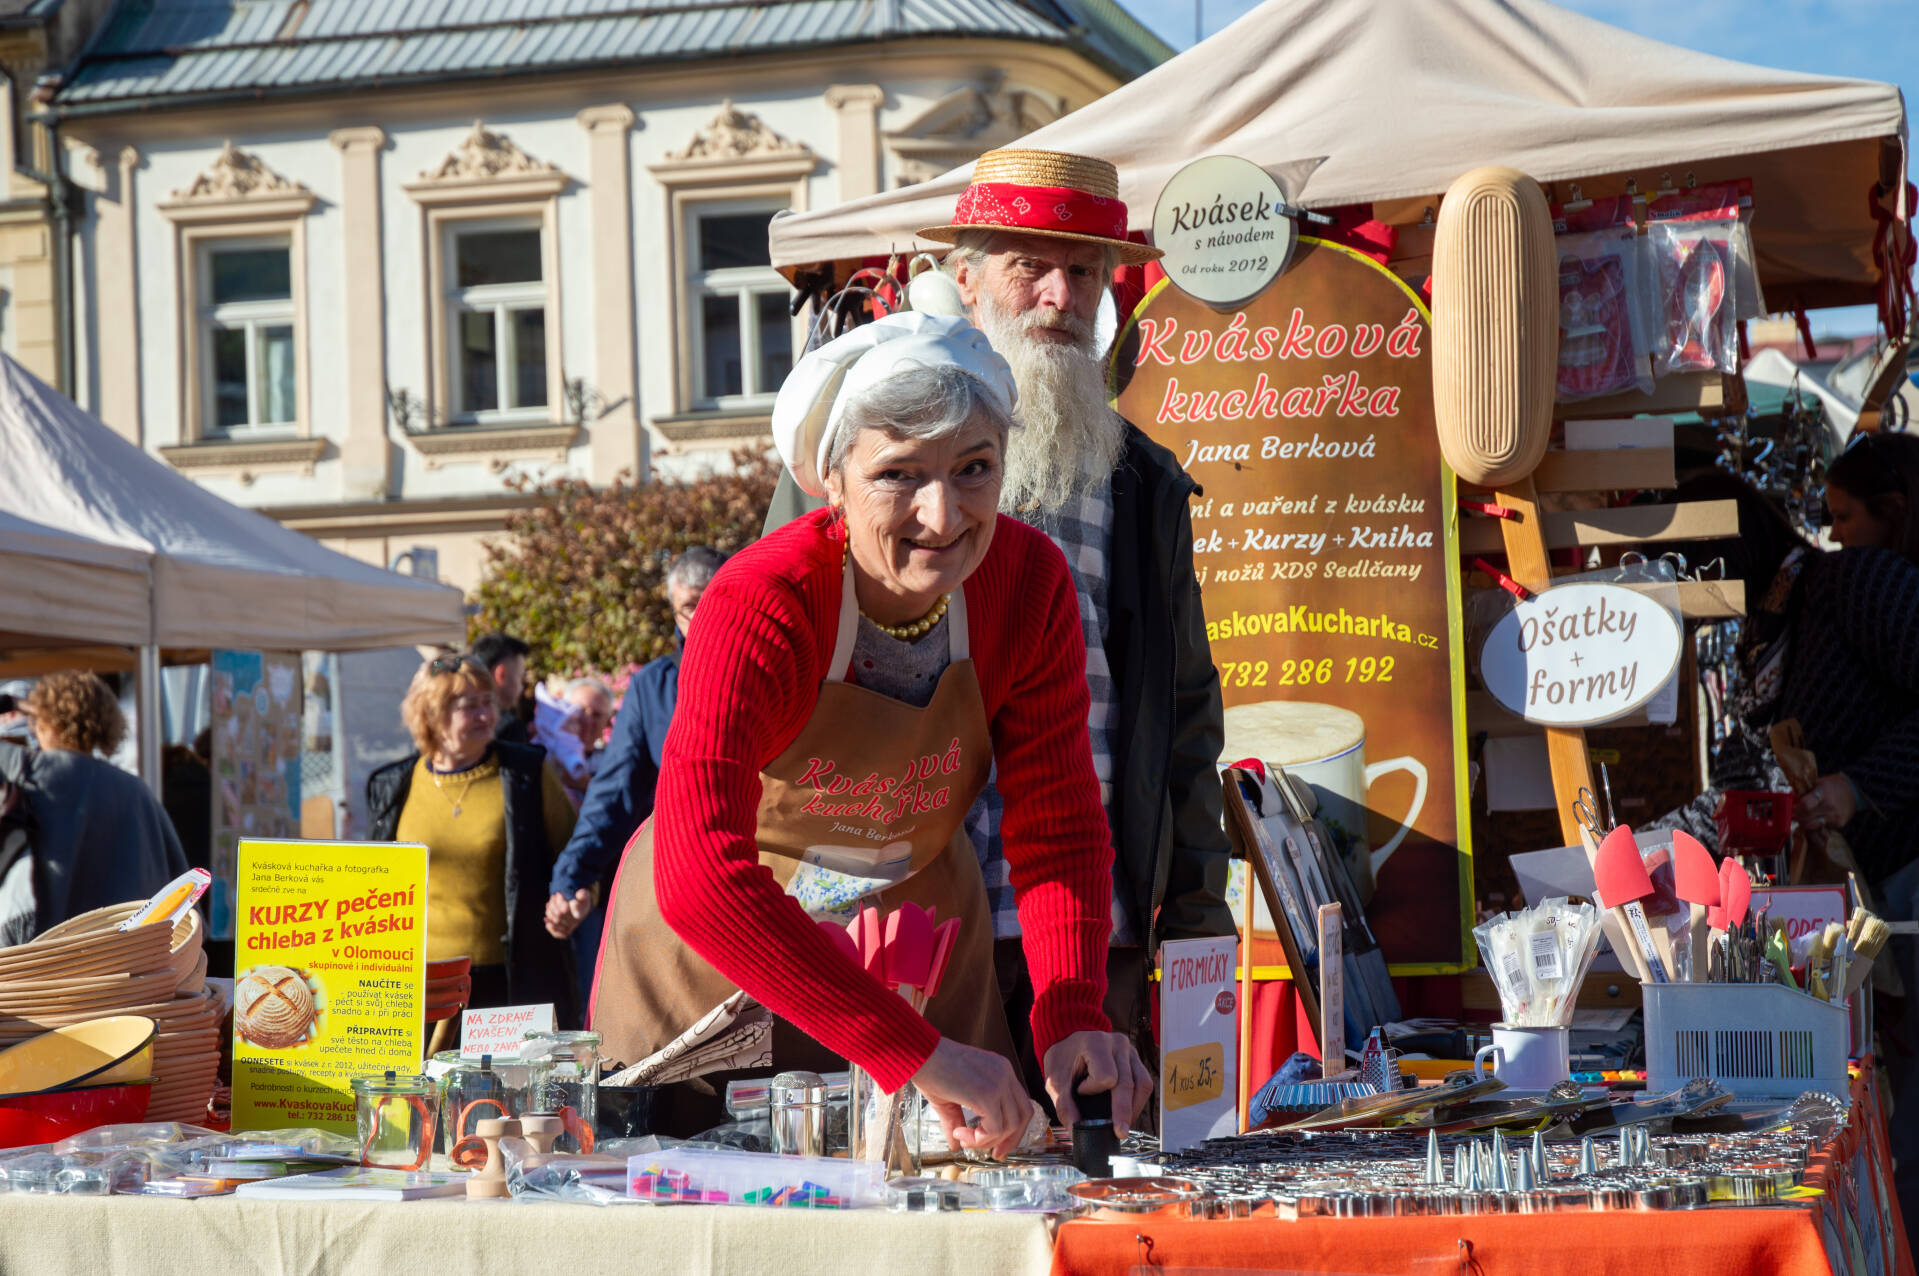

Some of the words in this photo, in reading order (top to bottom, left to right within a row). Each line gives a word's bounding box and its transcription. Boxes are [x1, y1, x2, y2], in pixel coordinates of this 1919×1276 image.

[1171, 191, 1270, 235] Kvásek
[1194, 237, 1202, 251] s
[1208, 228, 1274, 249] návodem
[1182, 263, 1197, 275] Od
[1200, 263, 1225, 274] roku
[1229, 256, 1268, 273] 2012
[1133, 308, 1422, 367] Kvásková
[1157, 371, 1400, 424] kuchařka
[1183, 440, 1250, 470] Jana
[1260, 433, 1376, 460] Berková
[1220, 503, 1234, 518] a
[1242, 494, 1316, 516] vaření
[1325, 500, 1337, 514] z
[1344, 493, 1425, 514] kvásku
[1214, 563, 1264, 583] nožů
[1270, 562, 1317, 580] KDS
[1323, 559, 1423, 581] Sedlčany
[1518, 596, 1637, 653] Ošatky
[1570, 651, 1584, 667] +
[1220, 660, 1269, 688] 732
[1279, 658, 1333, 685] 286
[1344, 655, 1395, 683] 192
[1529, 661, 1638, 706] formy
[831, 822, 862, 836] Jana
[252, 861, 292, 872] Kvásková
[294, 863, 334, 873] kuchařka
[344, 864, 389, 875] fotografka
[251, 873, 272, 883] Jana
[274, 873, 309, 883] Berková
[311, 875, 325, 884] vás
[251, 886, 281, 895] srdečně
[249, 898, 330, 926] KURZY
[336, 884, 416, 921] pečení
[247, 929, 316, 950] chleba
[322, 928, 334, 943] z
[340, 914, 414, 940] kvásku
[332, 949, 340, 958] v
[344, 946, 414, 961] Olomouci
[309, 961, 354, 971] skupinové
[361, 962, 413, 973] individuální
[1170, 948, 1229, 993] FORMIČKY
[359, 979, 401, 990] NAUČÍTE
[347, 990, 382, 1000] používat
[384, 991, 413, 1000] kvásek
[335, 998, 354, 1008] péct
[356, 998, 363, 1006] si
[365, 998, 383, 1008] svůj
[385, 999, 413, 1009] chleba
[331, 1007, 362, 1017] snadno
[378, 1008, 390, 1018] při
[392, 1009, 413, 1019] práci
[466, 1013, 482, 1025] NA
[346, 1024, 403, 1037] PŘIPRAVÍTE
[406, 1029, 413, 1037] si
[468, 1023, 522, 1040] KVAŠENÍ
[331, 1036, 346, 1044] své
[349, 1036, 369, 1046] těsto
[384, 1038, 412, 1049] chleba
[463, 1043, 490, 1054] NEBO
[319, 1045, 352, 1056] upečete
[355, 1046, 376, 1055] hned
[389, 1047, 412, 1057] doma
[240, 1056, 284, 1066] ODNESETE
[1169, 1064, 1178, 1094] 1
[307, 1111, 324, 1120] 732
[326, 1112, 343, 1121] 286
